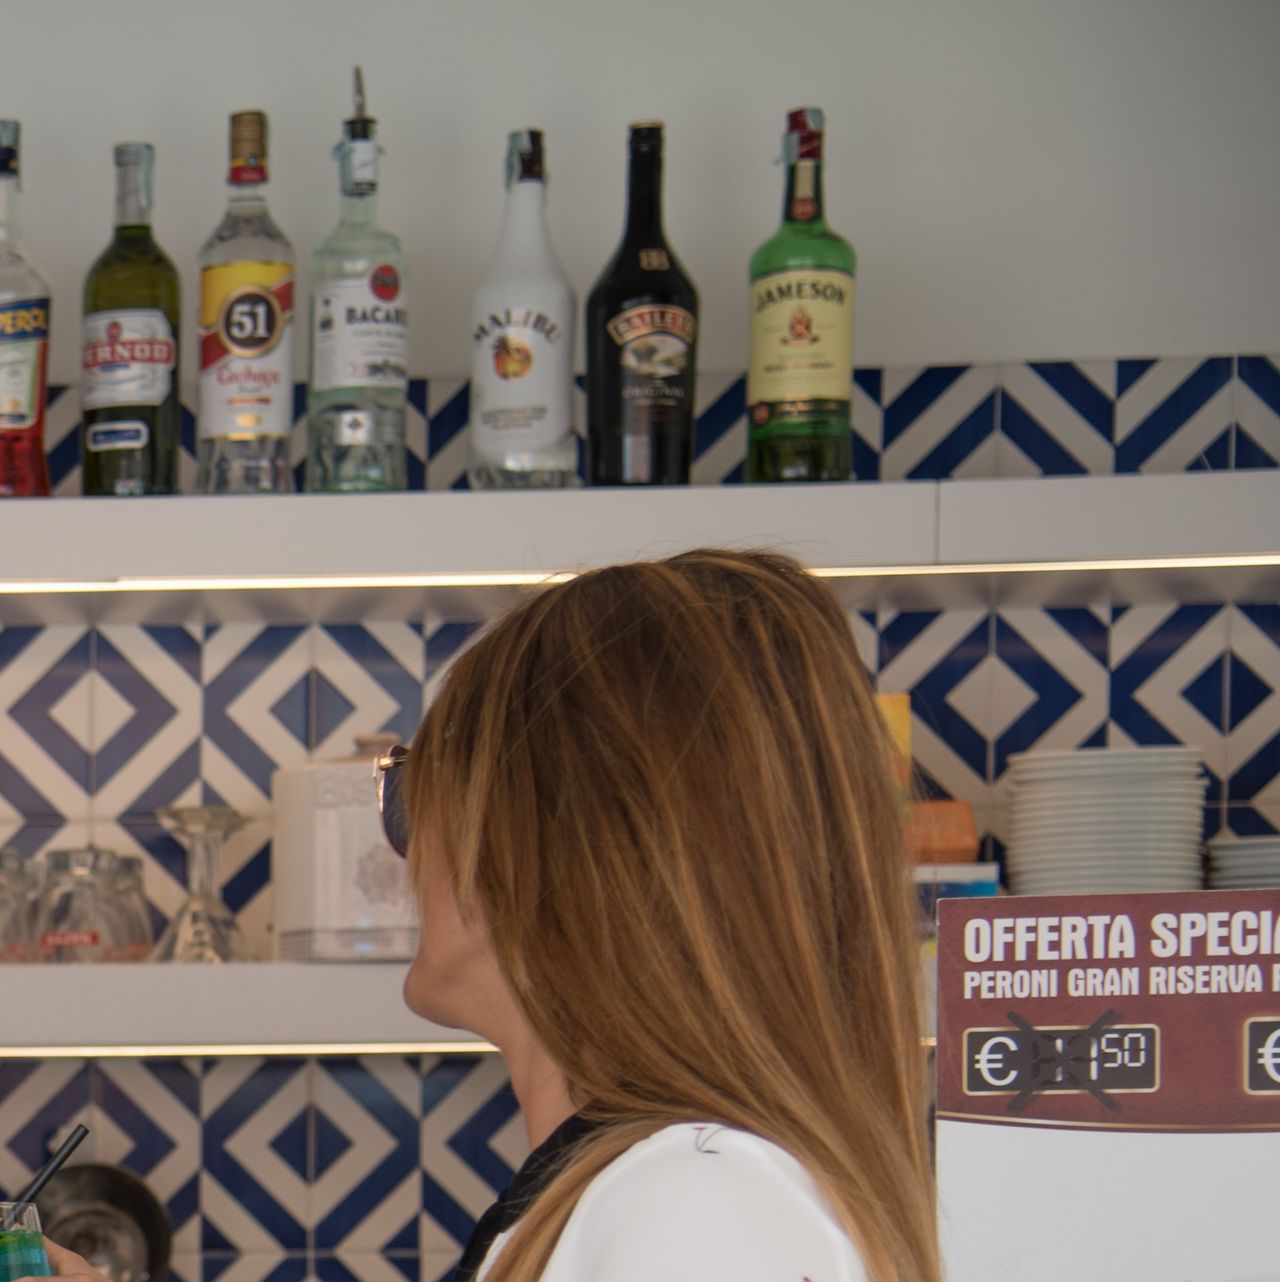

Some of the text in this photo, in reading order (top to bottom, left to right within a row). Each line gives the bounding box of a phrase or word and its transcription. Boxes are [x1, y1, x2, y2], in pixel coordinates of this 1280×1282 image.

[755, 278, 848, 312] JAMESON
[229, 302, 270, 340] 51
[473, 308, 561, 344] MALIBU
[612, 308, 696, 339] BAILEYS
[964, 914, 1136, 963] OFFERTA
[963, 968, 1058, 1000] PERONI
[1067, 966, 1140, 997] GRAN
[1149, 963, 1263, 995] RISERVA
